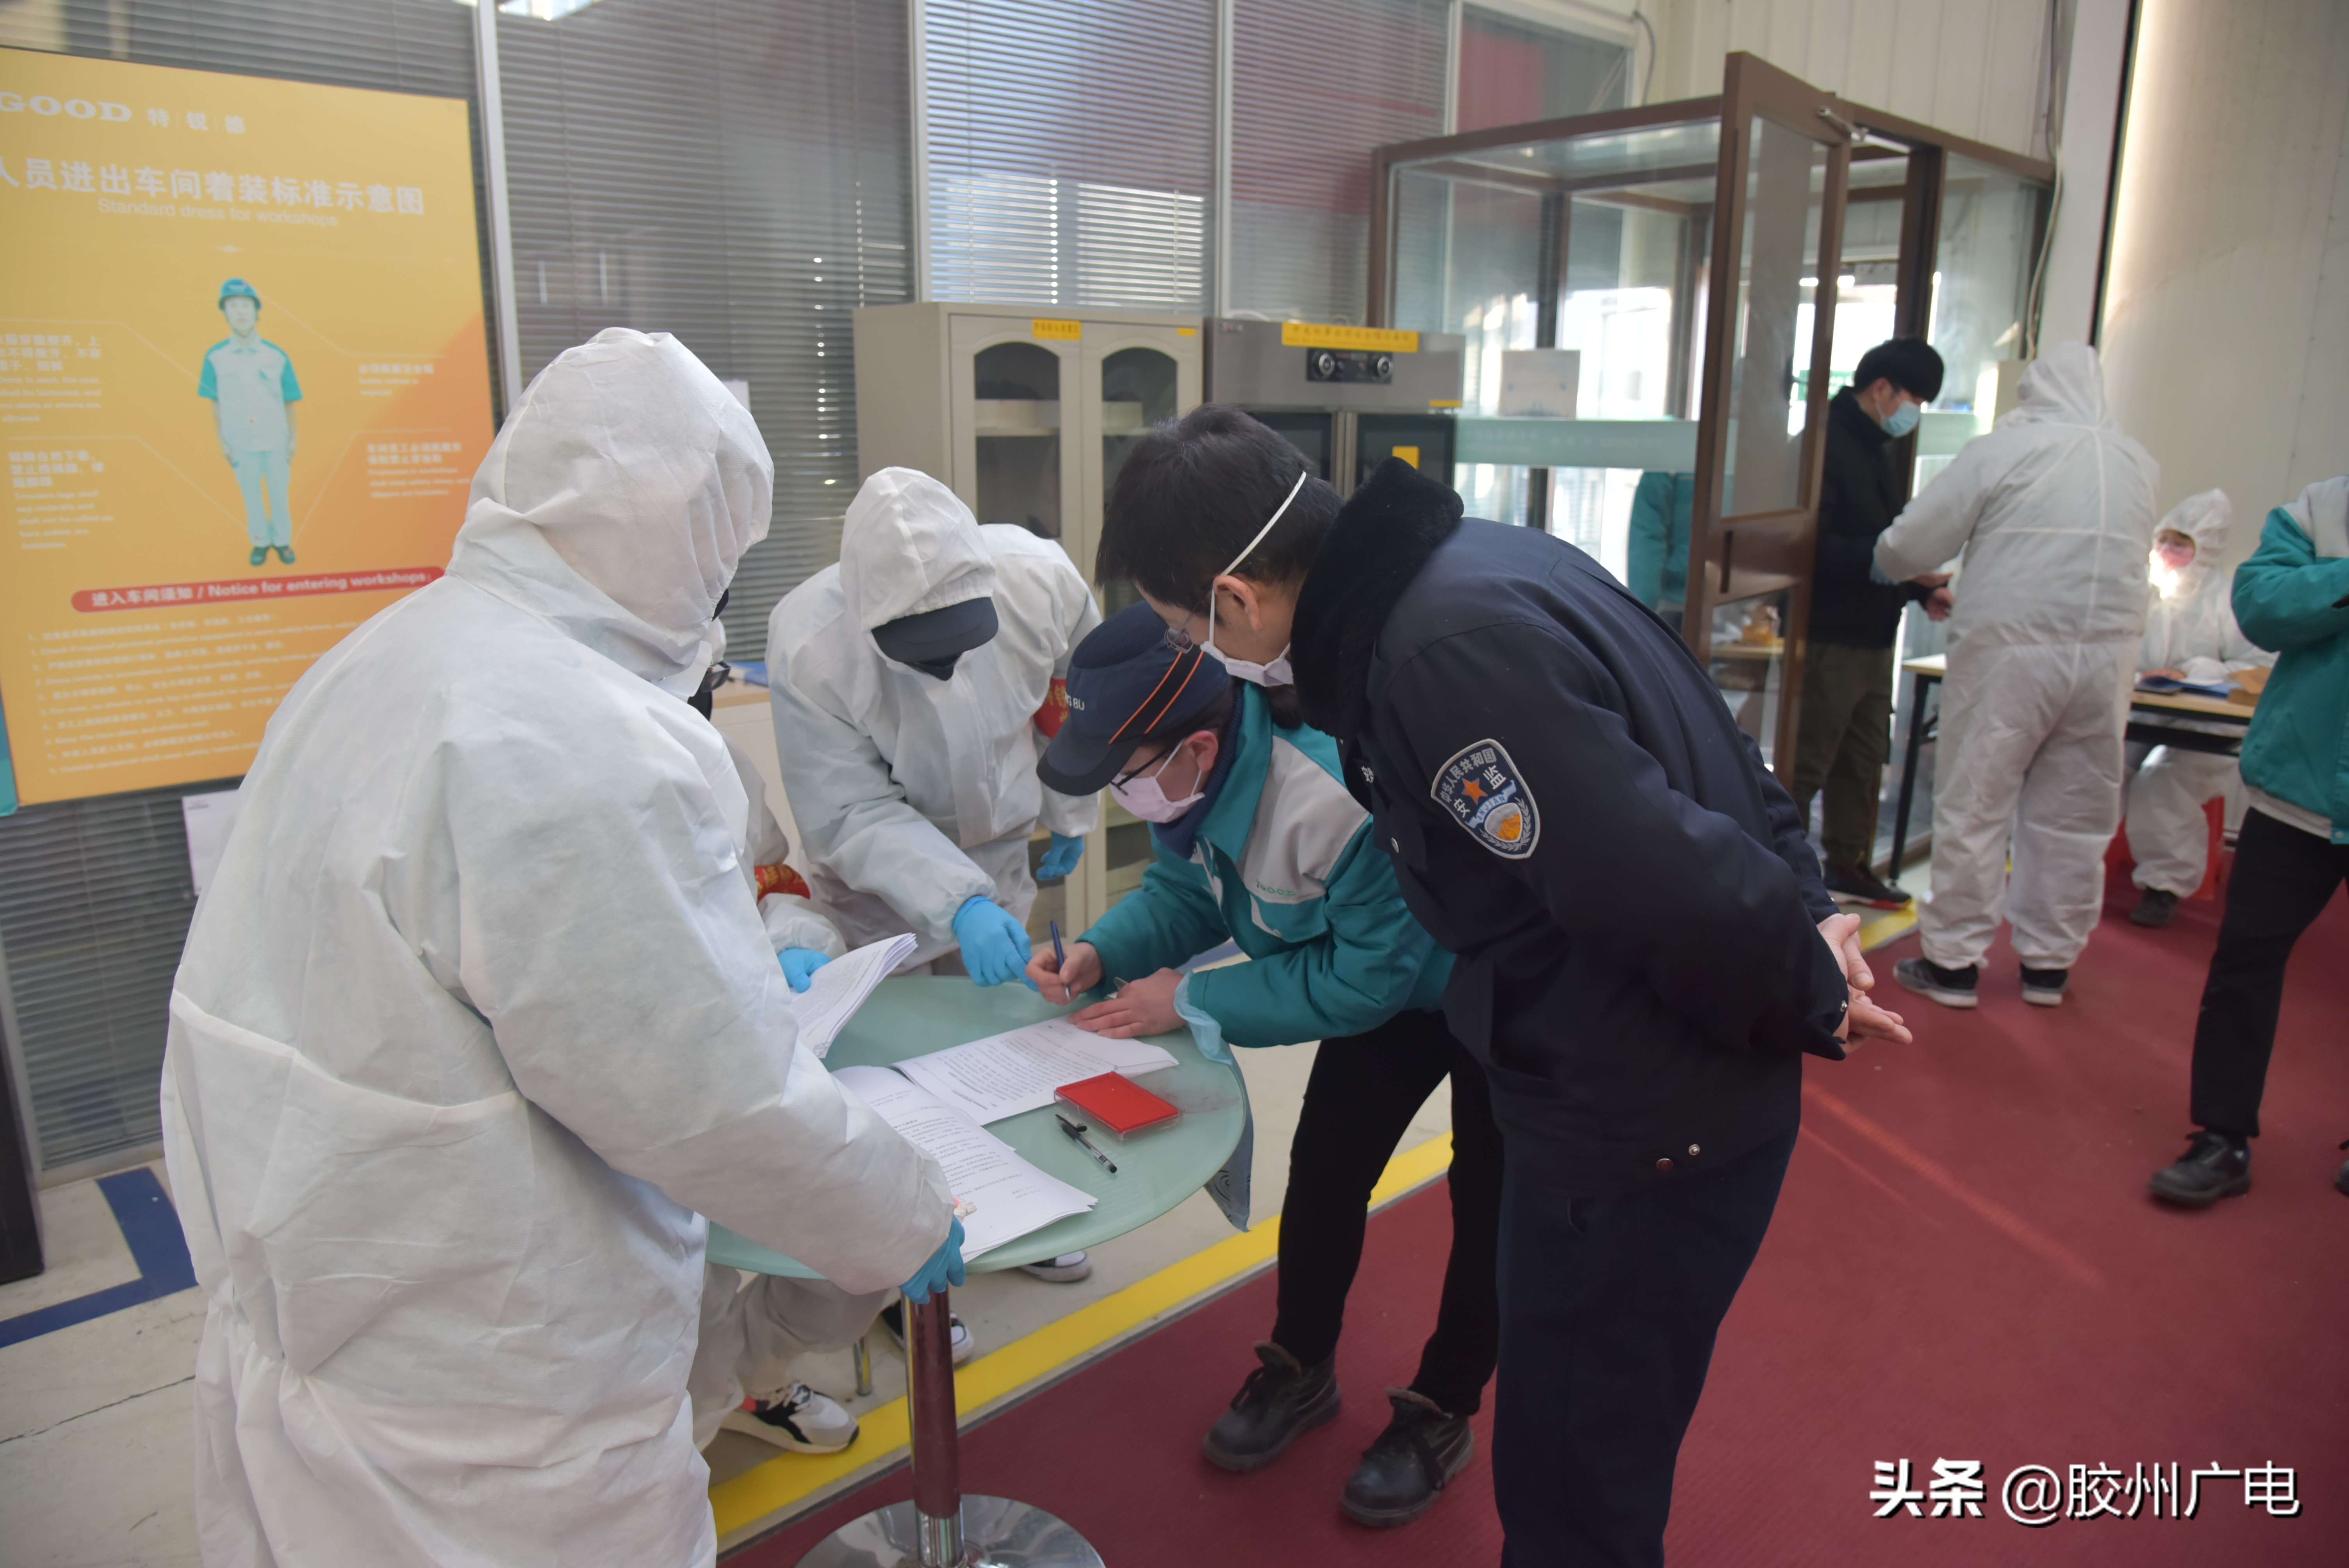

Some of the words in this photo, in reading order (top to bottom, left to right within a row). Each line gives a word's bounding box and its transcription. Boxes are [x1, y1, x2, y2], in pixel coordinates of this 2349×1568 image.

[0, 91, 132, 121] GOOD
[98, 198, 176, 217] Standard
[180, 203, 226, 220] dress
[230, 207, 251, 221] for
[256, 210, 339, 228] workshops
[92, 586, 194, 607] 进入车间须知
[208, 583, 258, 597] Notice
[261, 581, 283, 593] for
[286, 576, 348, 591] entering
[1073, 698, 1085, 711] BU
[1440, 748, 1497, 803] 中华人民共和国
[1477, 795, 1506, 821] ANJIAN
